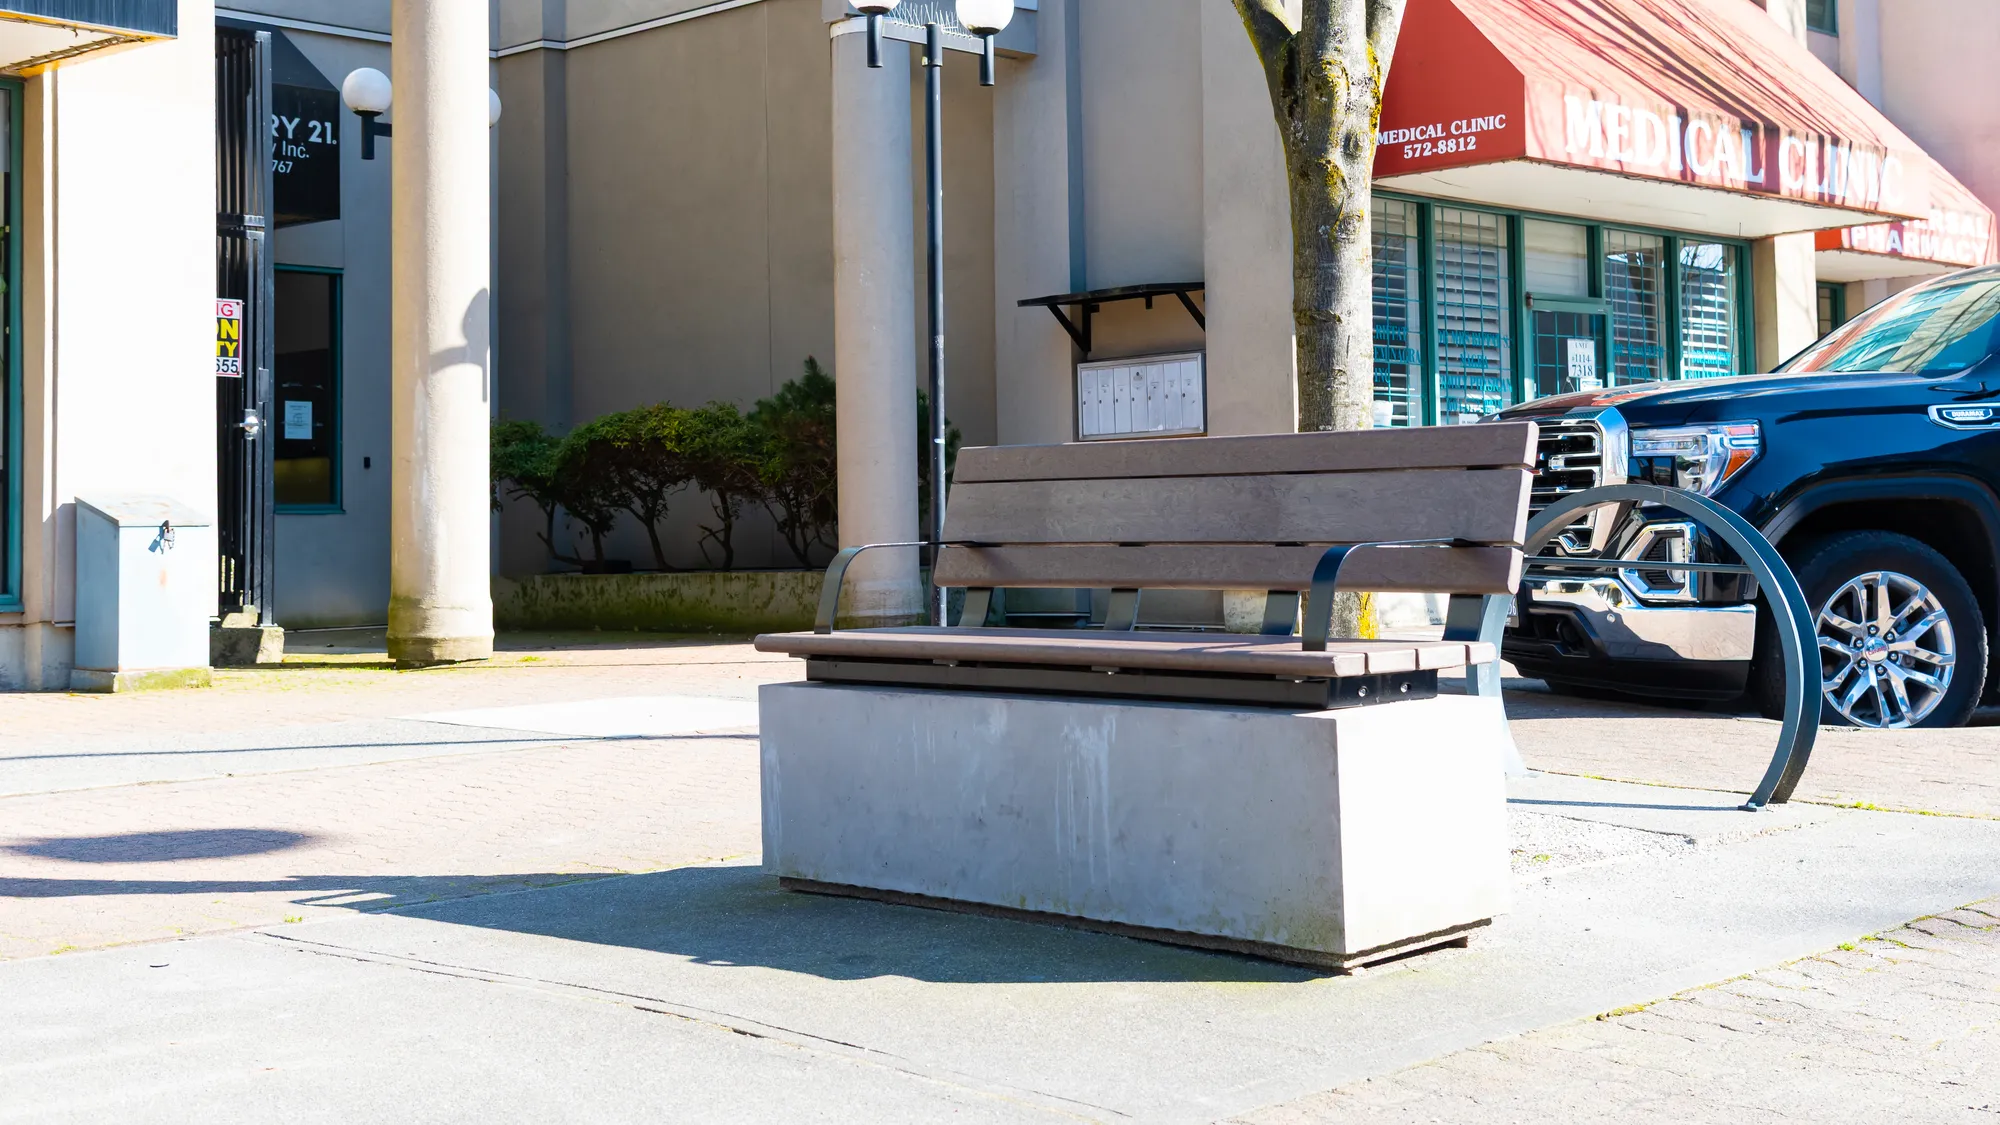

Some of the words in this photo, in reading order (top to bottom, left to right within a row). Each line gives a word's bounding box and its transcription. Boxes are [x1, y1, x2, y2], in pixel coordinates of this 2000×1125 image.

[1377, 124, 1446, 146] MEDICAL
[1450, 114, 1506, 135] CLINIC
[282, 140, 310, 159] Inc.
[1403, 136, 1477, 159] 572-8812
[1564, 96, 1764, 183] MEDICAL
[1778, 135, 1904, 209] CLINIC
[1851, 226, 1988, 266] PHARMACY
[1572, 364, 1593, 377] 7318
[1951, 410, 1985, 418] DURAMAX
